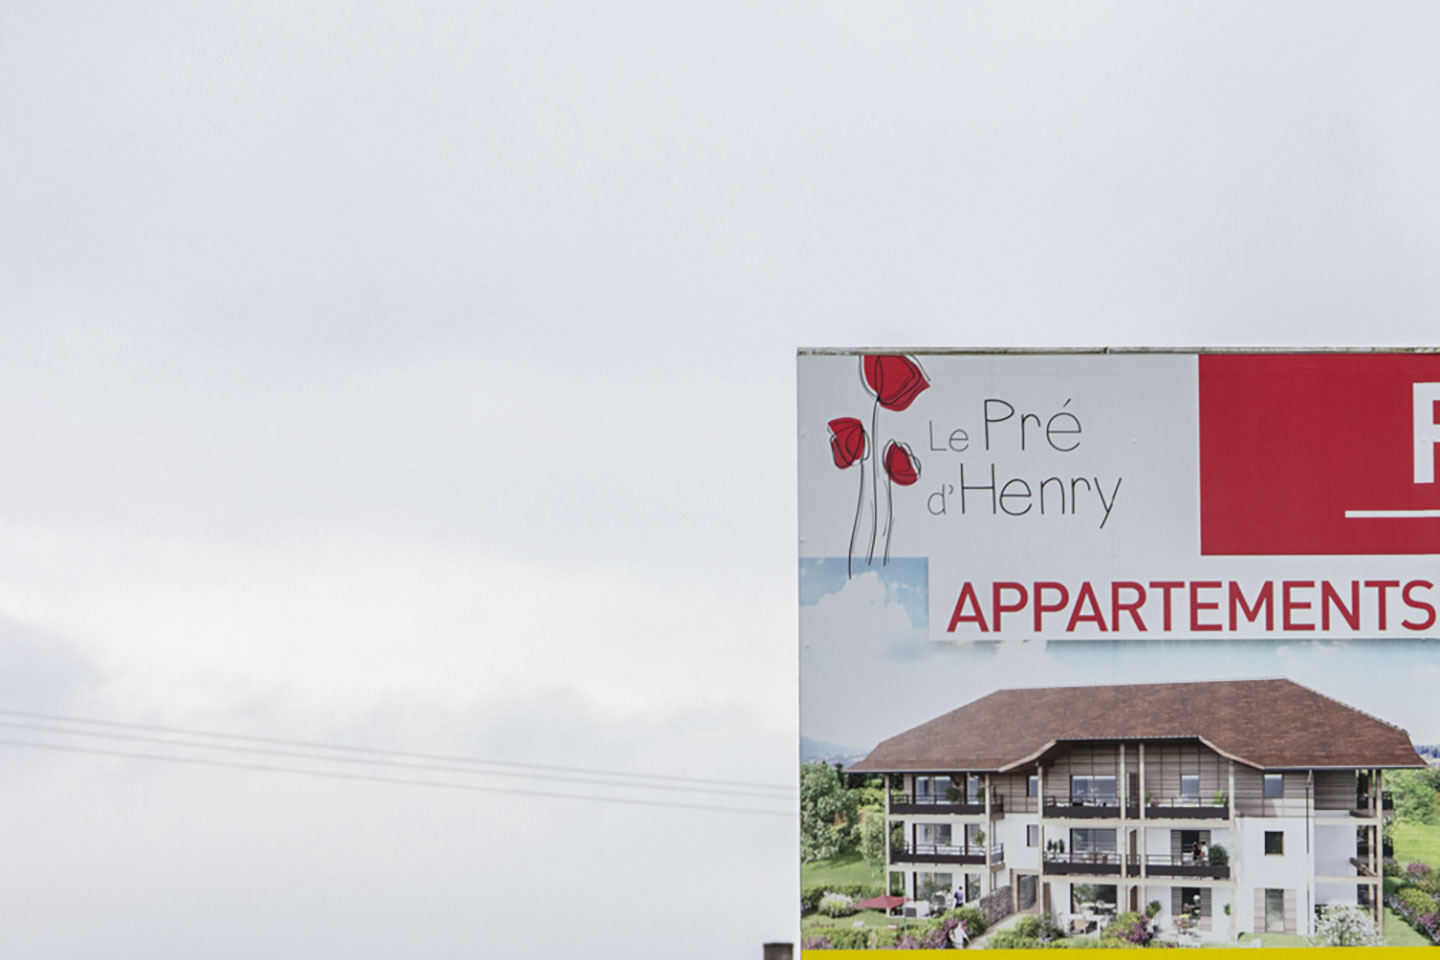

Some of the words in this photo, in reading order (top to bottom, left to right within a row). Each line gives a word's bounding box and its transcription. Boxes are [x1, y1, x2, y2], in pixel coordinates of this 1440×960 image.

[928, 420, 970, 452] Le
[983, 397, 1083, 453] Pré
[927, 462, 1123, 530] d'Henry
[947, 579, 1437, 633] APPARTEMENTS
